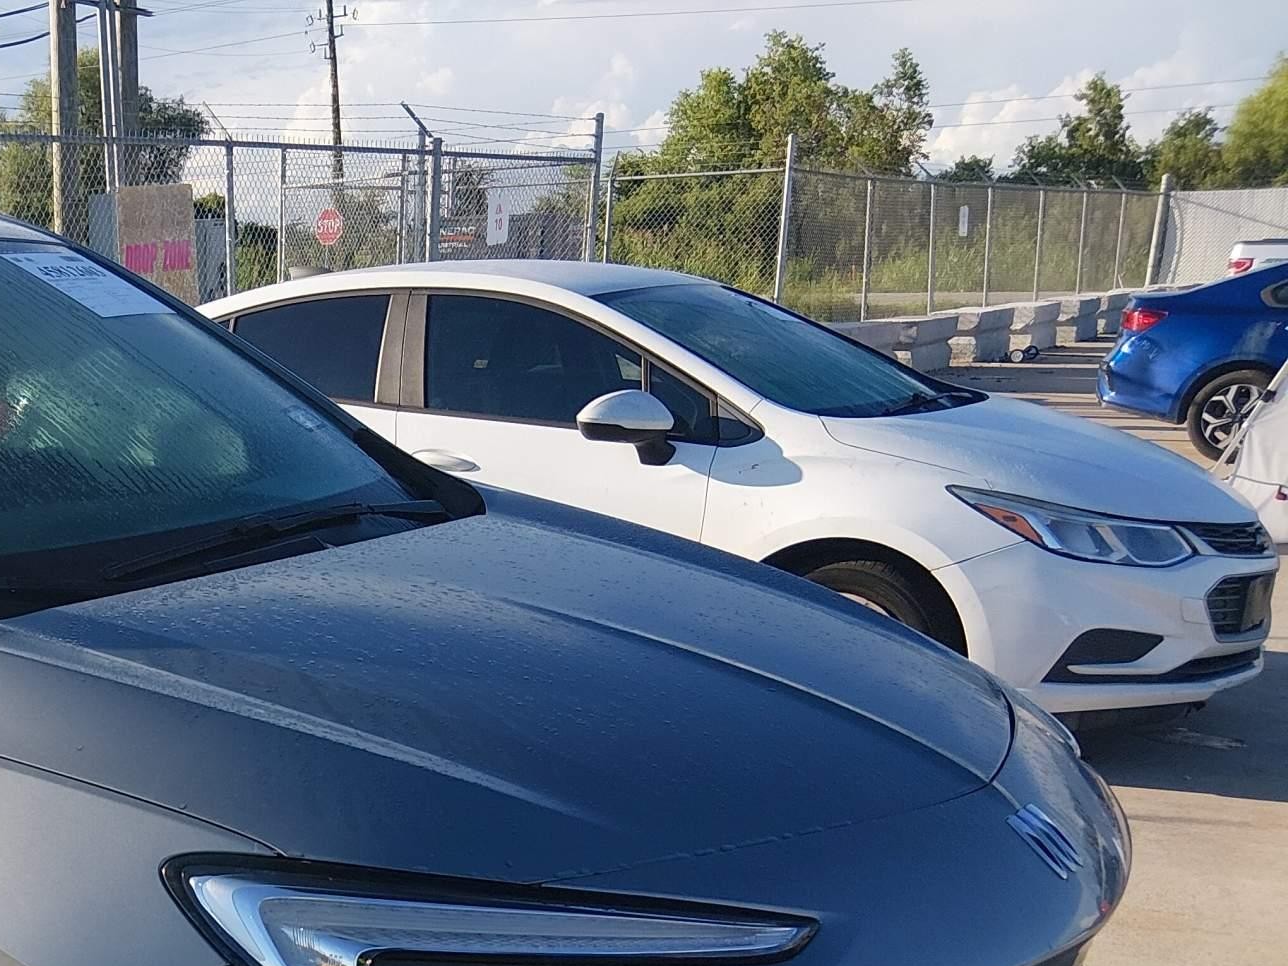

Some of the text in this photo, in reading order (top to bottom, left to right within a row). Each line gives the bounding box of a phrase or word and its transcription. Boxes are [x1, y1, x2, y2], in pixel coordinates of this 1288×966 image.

[317, 218, 341, 233] STOP
[494, 217, 504, 232] 10
[125, 239, 191, 273] DROP ZONE
